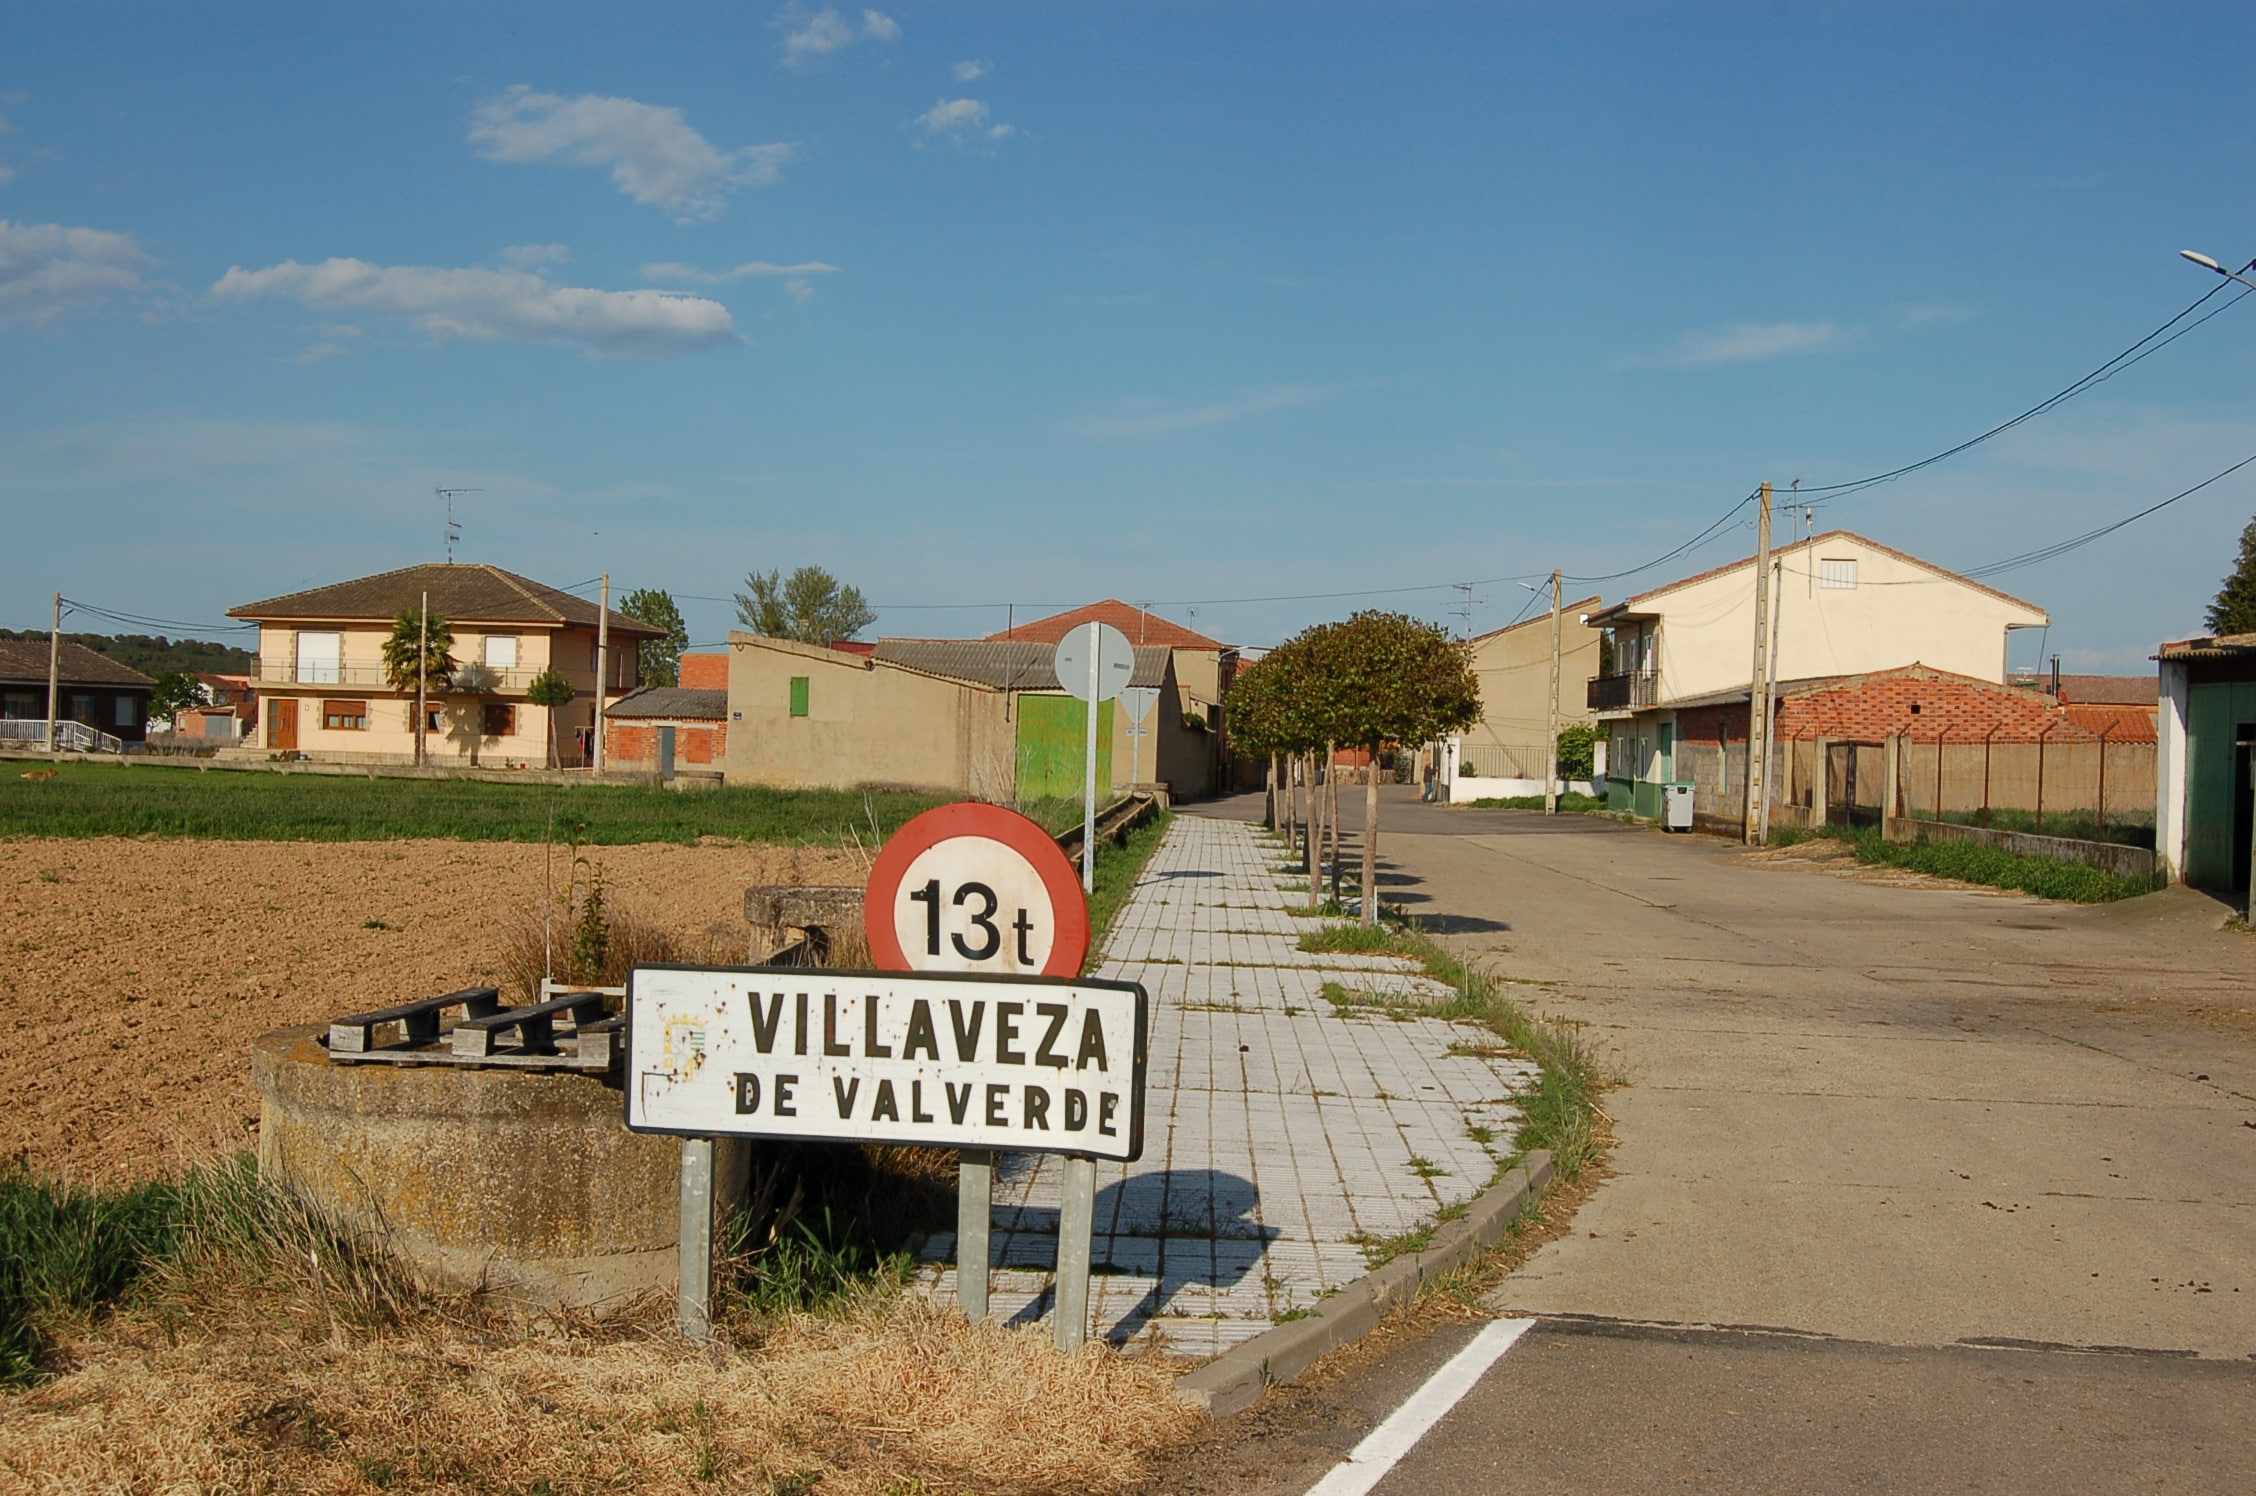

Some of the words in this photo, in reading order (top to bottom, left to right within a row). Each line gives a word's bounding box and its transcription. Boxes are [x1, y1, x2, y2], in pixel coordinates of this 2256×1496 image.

[748, 992, 1108, 1072] VILLAVEZA
[735, 1072, 799, 1117] DE
[833, 1078, 1119, 1137] VALVERDE
